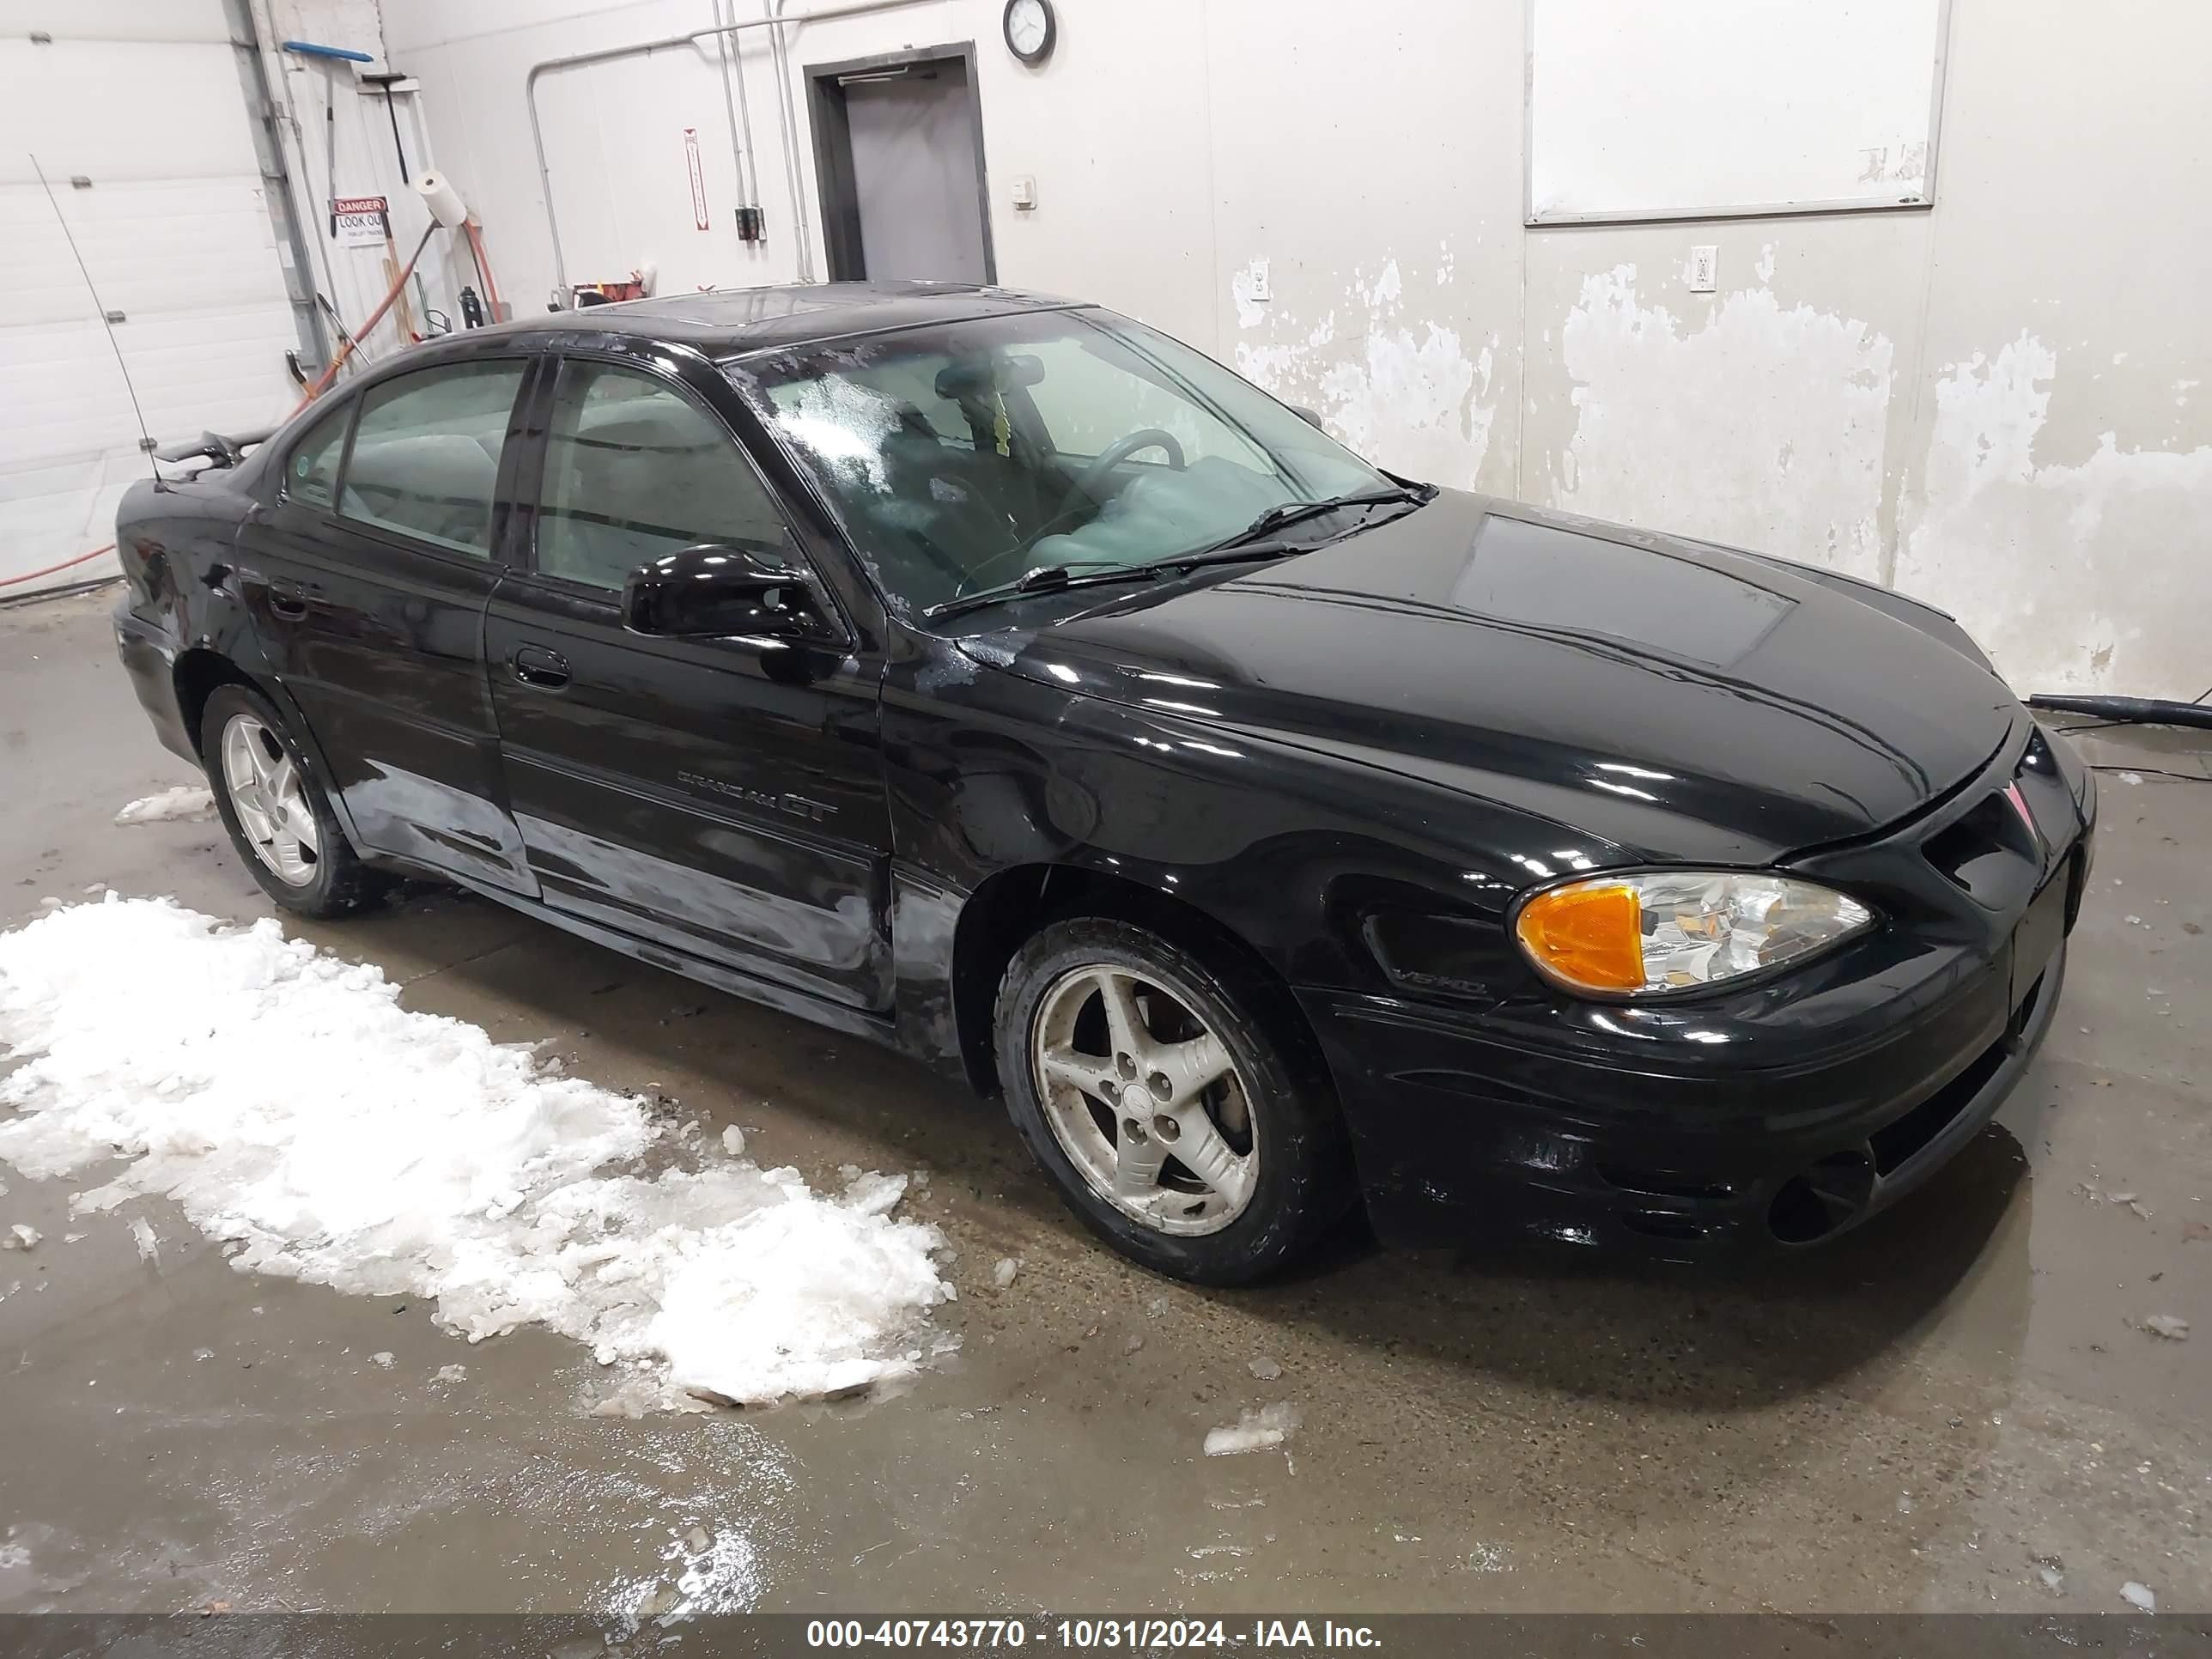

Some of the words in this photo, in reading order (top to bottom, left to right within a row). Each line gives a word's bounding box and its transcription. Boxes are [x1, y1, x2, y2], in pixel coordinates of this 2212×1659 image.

[337, 200, 381, 212] DANGER
[339, 216, 367, 228] LOOK
[367, 214, 381, 225] OU
[778, 793, 838, 822] GT
